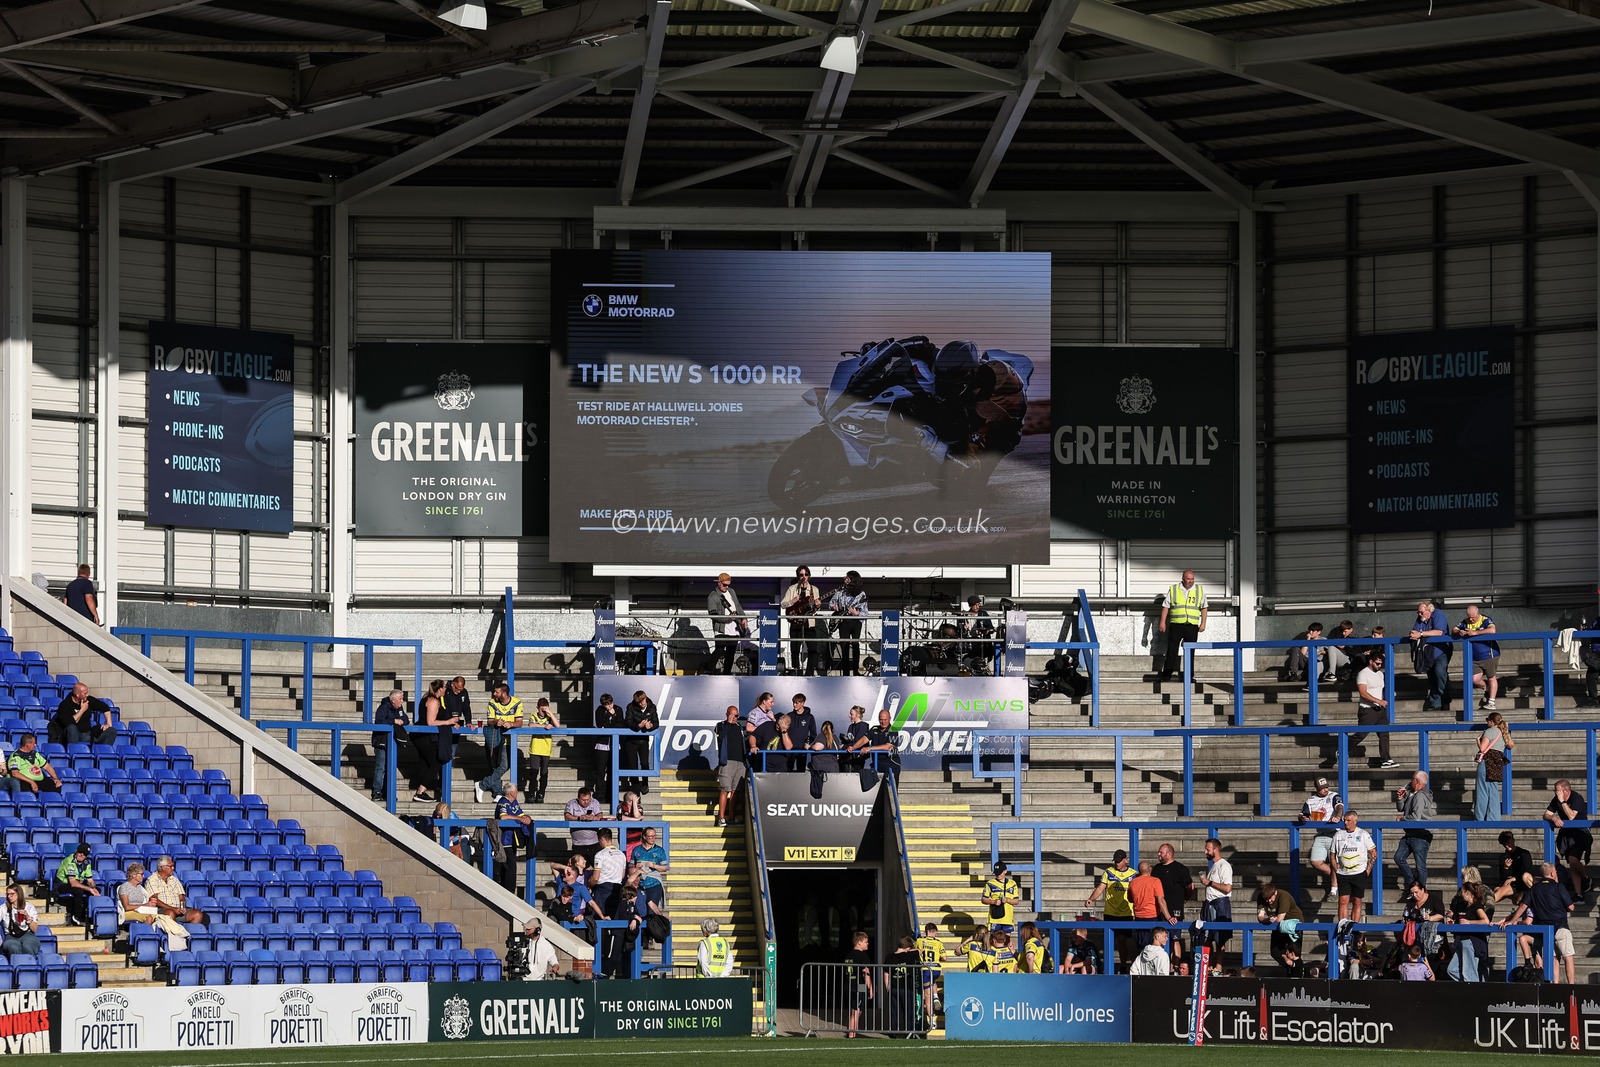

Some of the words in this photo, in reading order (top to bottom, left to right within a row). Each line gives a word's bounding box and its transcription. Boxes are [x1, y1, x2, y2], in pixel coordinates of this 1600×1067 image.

[608, 294, 638, 305] BMW
[608, 307, 675, 317] MOTORRAD
[577, 363, 623, 383] THE
[629, 364, 684, 383] NEW
[688, 364, 703, 384] S
[709, 365, 767, 384] 1000
[772, 366, 802, 384] RR
[173, 389, 200, 406] NEWS
[577, 401, 604, 411] TEST
[605, 401, 631, 411] RIDE
[632, 402, 646, 411] AT
[647, 402, 706, 412] HALLIWELL
[707, 403, 743, 412] JONES
[1376, 399, 1406, 415] NEWS
[576, 415, 640, 425] MOTORRAD
[172, 421, 224, 440] PHONE-INS
[1376, 428, 1434, 446] PHONE-INS
[371, 421, 538, 462] GREENALL'S
[1053, 424, 1219, 466] GREENALL'S
[172, 454, 221, 473] PODCASTS
[1376, 462, 1430, 479] PODCASTS
[412, 477, 436, 486] THE
[440, 476, 497, 486] ORIGINAL
[1111, 480, 1145, 489] MADE
[1149, 480, 1161, 489] IN
[172, 488, 206, 506] MATCH
[208, 491, 280, 510] COMMENTARIES
[402, 491, 454, 501] LONDON
[459, 492, 482, 501] DRY
[485, 492, 507, 501] GIN
[1096, 495, 1176, 504] WARRINGTON
[1376, 496, 1413, 513] MATCH
[1416, 492, 1499, 511] COMMENTARIES
[425, 506, 459, 515] SINCE
[463, 506, 484, 515] 1761
[579, 509, 612, 519] MAKE
[613, 509, 636, 519] LIFE
[637, 510, 646, 519] A
[647, 509, 672, 519] RIDE
[1107, 510, 1140, 519] SINCE
[1144, 510, 1165, 519] 1761
[990, 525, 1008, 534] apply.
[1188, 596, 1196, 604] 73
[766, 803, 809, 817] SEAT
[811, 803, 874, 818] UNIQUE
[787, 849, 805, 859] V11
[811, 849, 838, 859] EXIT
[919, 950, 935, 962] 19
[92, 994, 129, 1009] BIRRIFICIO
[187, 991, 225, 1007] BIRRIFICIO
[279, 989, 314, 1004] BIRRIFICIO
[366, 988, 403, 1003] BIRRIFICIO
[191, 1006, 221, 1019] ANGELO
[283, 1003, 310, 1017] ANGELO
[370, 1002, 399, 1015] ANGELO
[600, 1001, 623, 1013] THE
[627, 999, 682, 1012] ORIGINAL
[685, 998, 734, 1011] LONDON
[993, 1001, 1063, 1022] Halliwell
[1066, 1003, 1115, 1024] Jones
[96, 1008, 125, 1022] ANGELO
[480, 996, 585, 1035] GREENALL'S
[358, 1016, 411, 1042] PORETTI
[616, 1018, 639, 1030] DRY
[643, 1018, 664, 1030] GIN
[667, 1017, 698, 1029] SINCE
[702, 1016, 722, 1028] 1761
[1219, 1011, 1256, 1040] Lift
[1259, 1026, 1268, 1041] &
[1272, 1012, 1394, 1044] Escalator
[82, 1023, 138, 1050] PORETTI
[177, 1020, 234, 1047] PORETTI
[270, 1018, 323, 1044] PORETTI
[1474, 1017, 1518, 1048] UK
[1524, 1018, 1566, 1050] Lift
[1570, 1035, 1580, 1050] &
